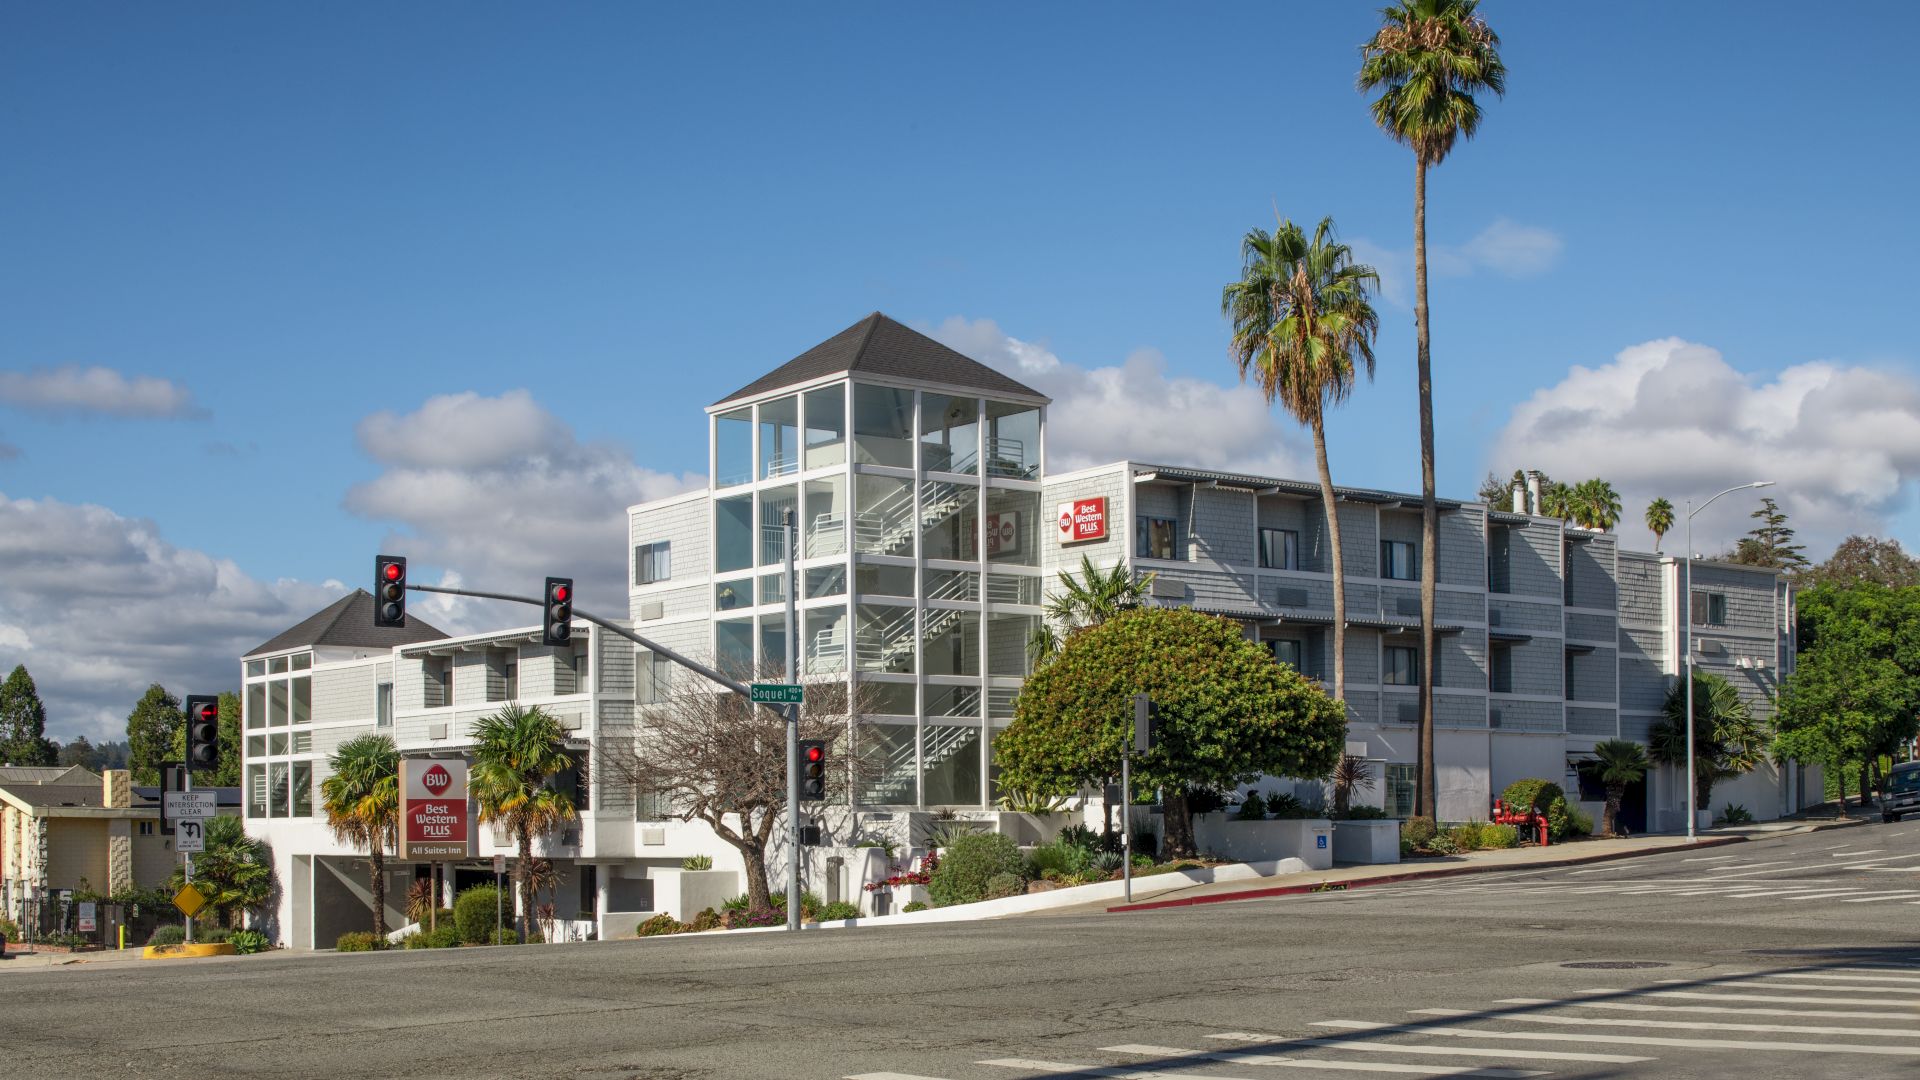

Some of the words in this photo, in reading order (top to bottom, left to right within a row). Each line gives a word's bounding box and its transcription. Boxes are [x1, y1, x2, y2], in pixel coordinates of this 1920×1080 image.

[1081, 504, 1096, 514] Best
[1060, 518, 1071, 527] BW
[1075, 512, 1102, 524] Western
[1080, 521, 1097, 533] PLUS
[752, 687, 786, 701] Soquel
[426, 774, 448, 786] BW
[167, 801, 214, 809] INTERSECTION
[425, 804, 448, 814] Best
[415, 814, 458, 825] Western
[424, 825, 450, 836] PLUS
[411, 846, 423, 855] All
[424, 846, 447, 855] Suites
[448, 846, 461, 855] Inn
